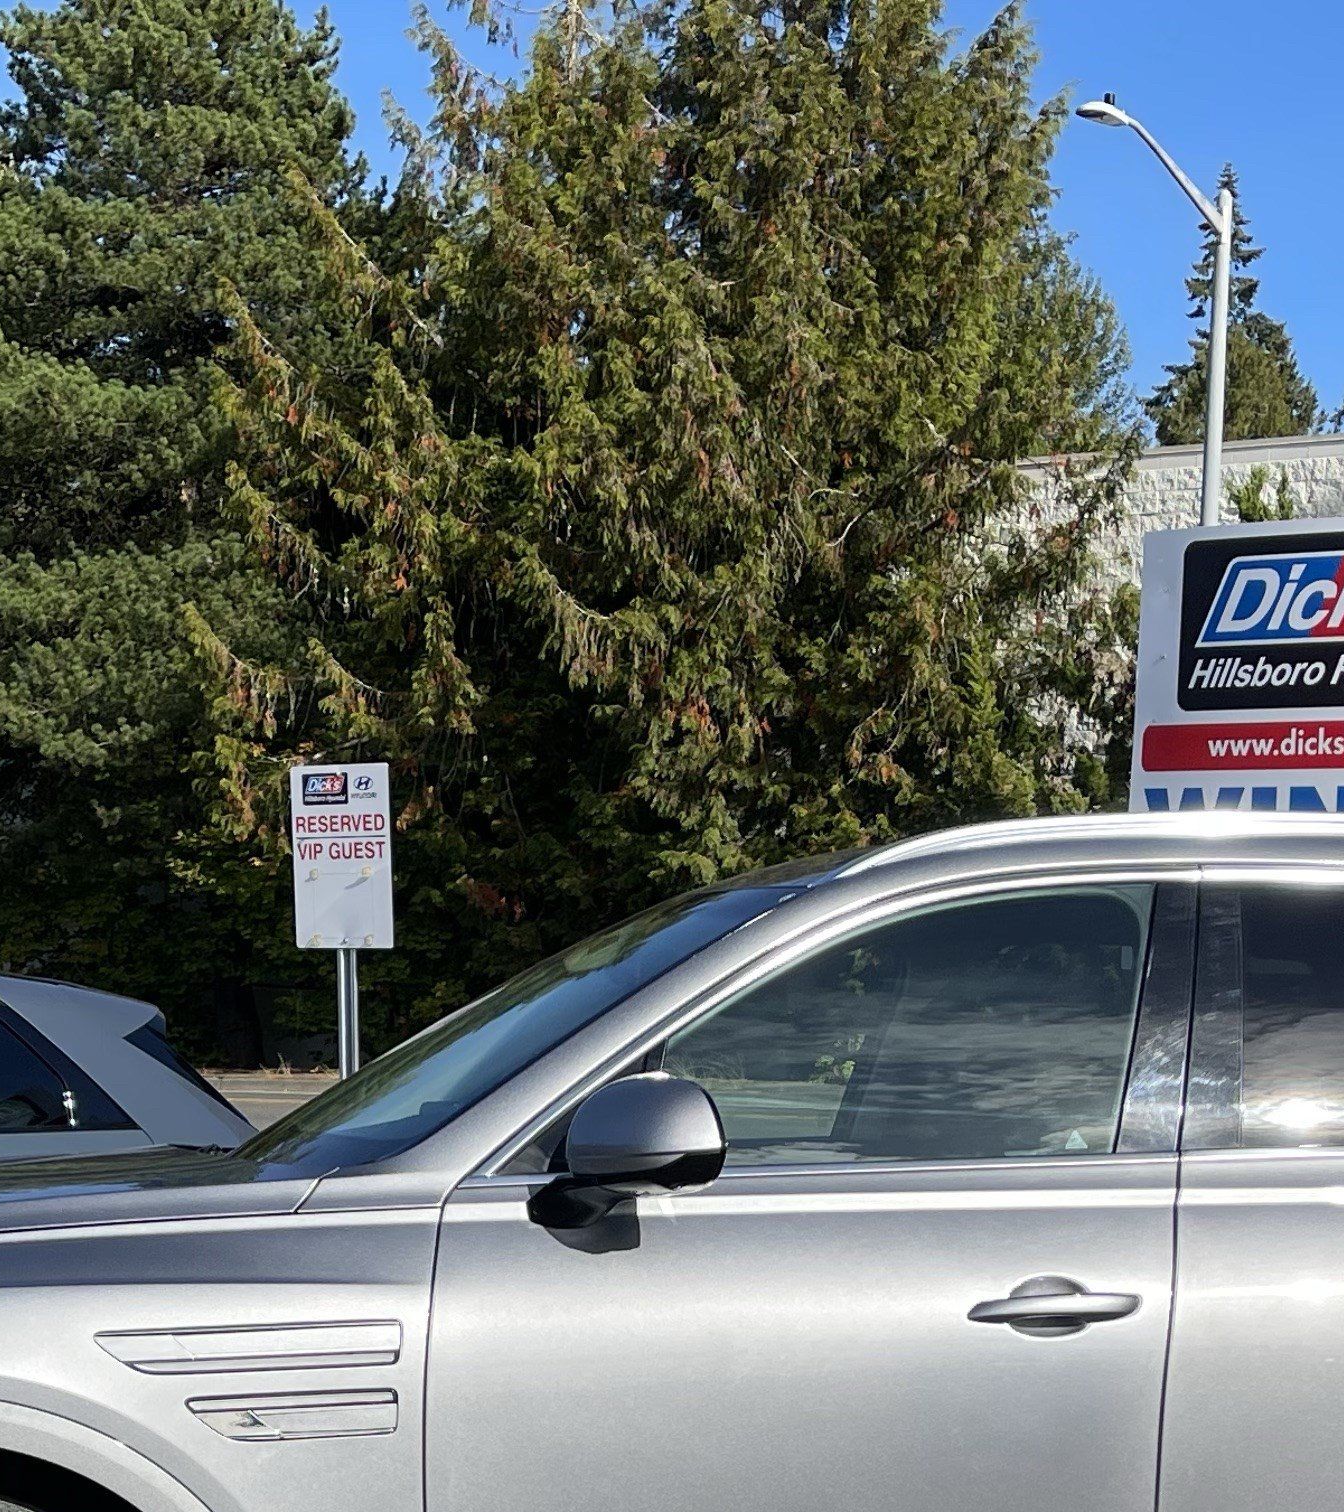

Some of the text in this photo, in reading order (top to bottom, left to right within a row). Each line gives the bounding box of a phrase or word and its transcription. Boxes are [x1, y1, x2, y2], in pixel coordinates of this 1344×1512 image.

[1188, 655, 1327, 690] Hillsboro
[295, 813, 385, 833] RESERVED
[297, 841, 385, 860] VIP GUEST
